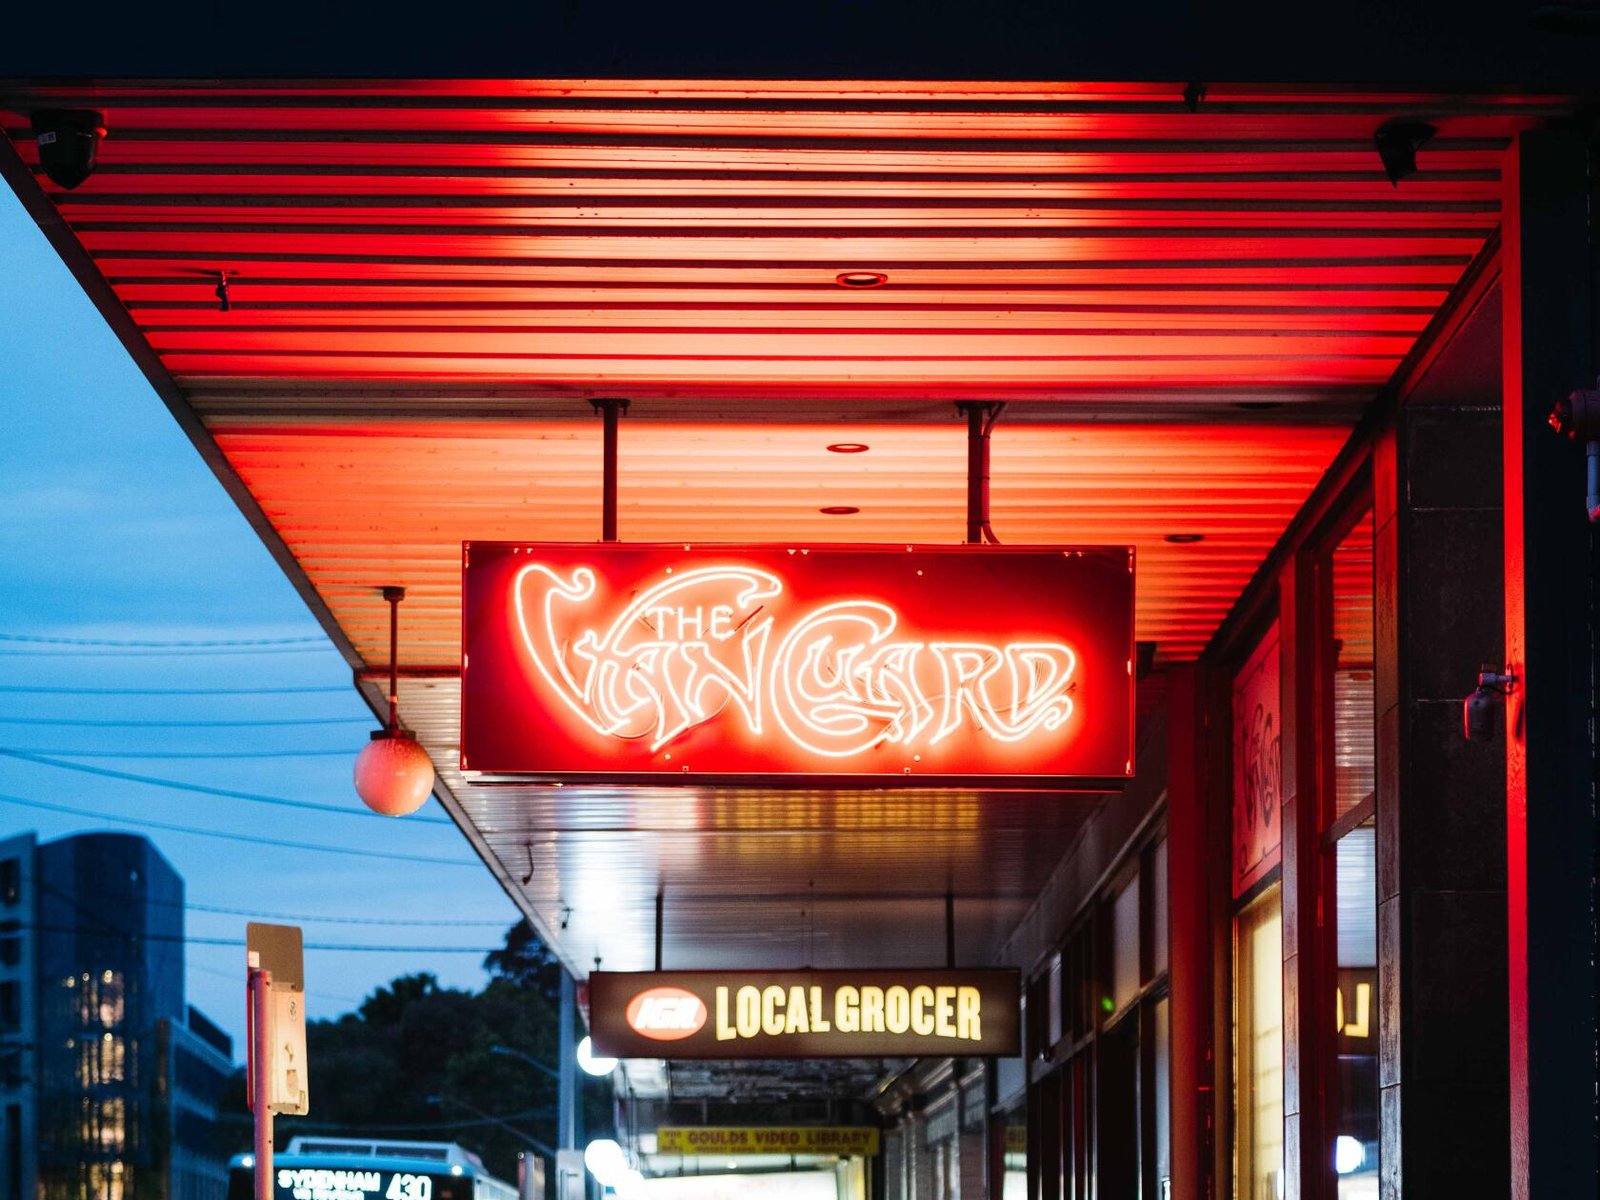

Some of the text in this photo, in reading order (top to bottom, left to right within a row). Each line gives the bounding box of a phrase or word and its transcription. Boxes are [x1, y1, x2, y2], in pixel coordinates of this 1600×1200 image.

[652, 603, 735, 641] THE
[715, 985, 831, 1041] LOCAL
[835, 985, 983, 1042] GROCER
[688, 1131, 749, 1146] GOULDS
[754, 1131, 800, 1146] VIDEO
[806, 1131, 872, 1146] LIBRARY
